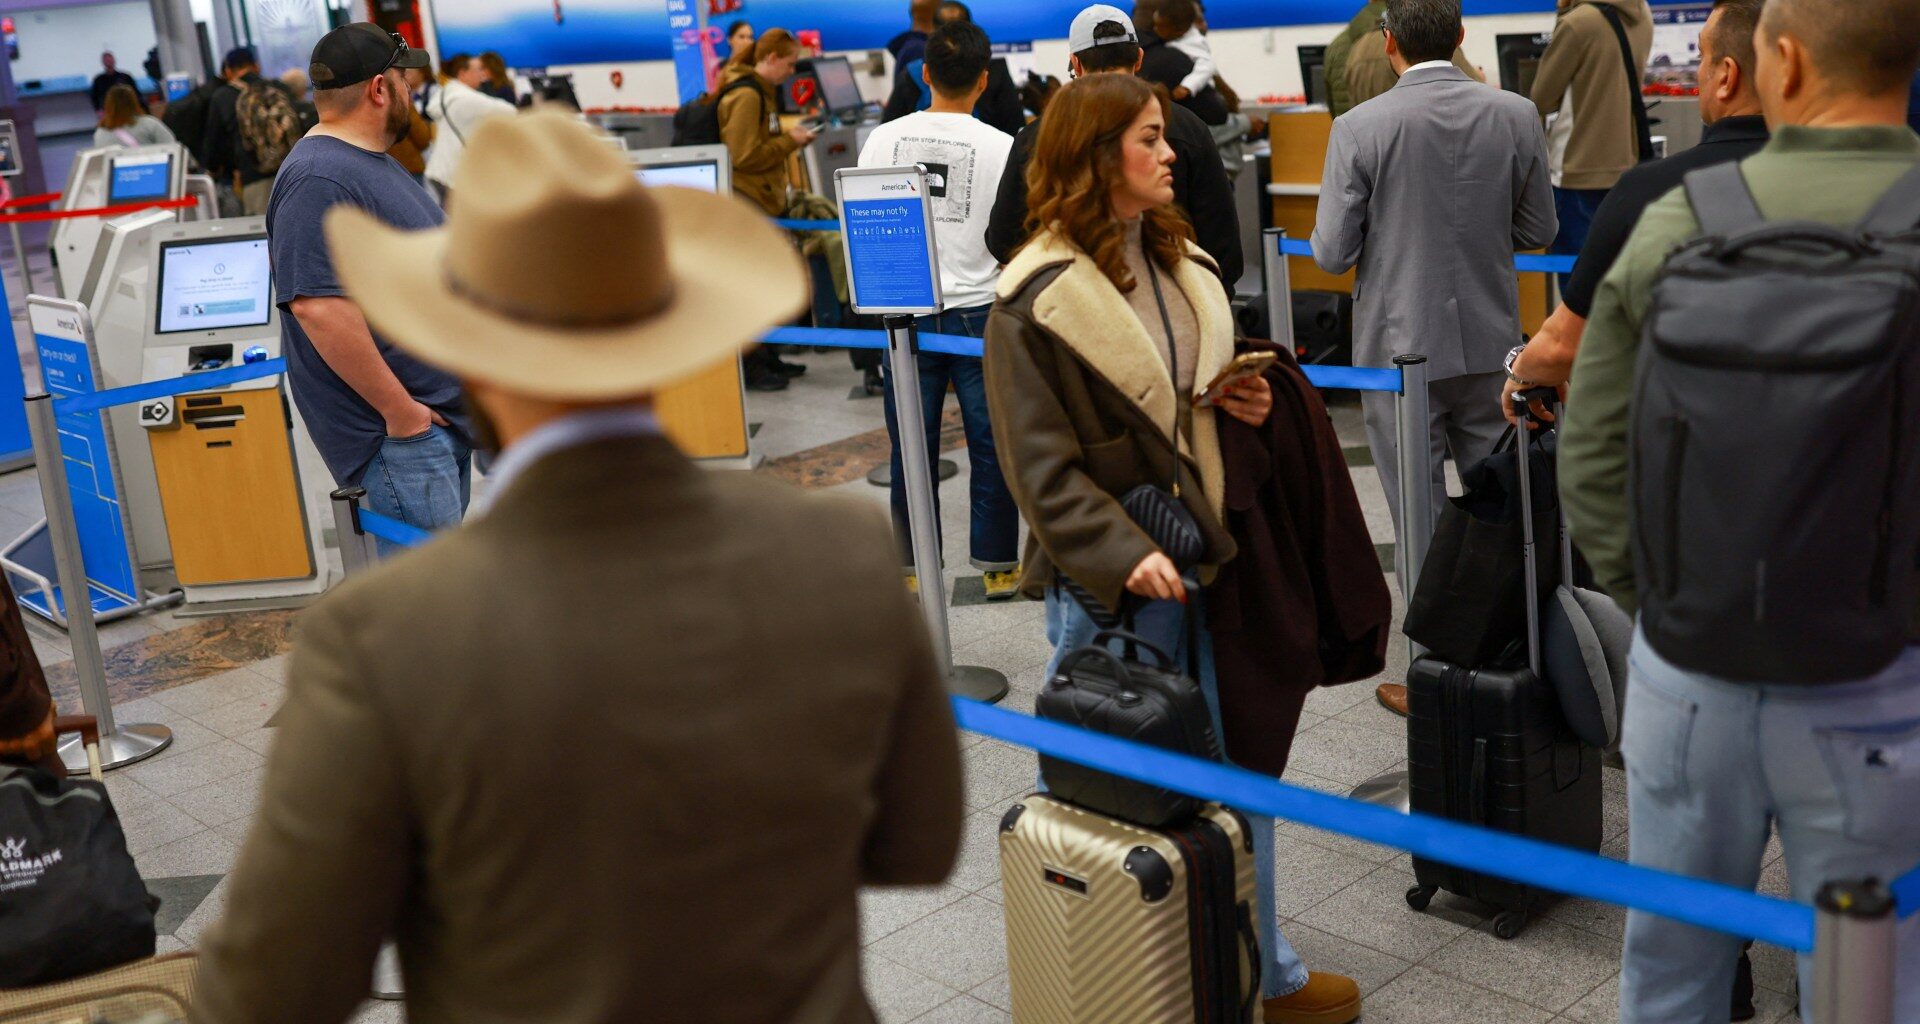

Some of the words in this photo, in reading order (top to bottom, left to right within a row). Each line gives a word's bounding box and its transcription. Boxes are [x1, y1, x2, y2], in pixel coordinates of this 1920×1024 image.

[937, 139, 972, 148] EXPLORING
[967, 148, 976, 168] NEVER
[965, 168, 974, 185] STOP
[881, 183, 908, 191] American
[964, 185, 972, 218] EXPLORING
[850, 208, 870, 216] These
[871, 209, 885, 218] may
[886, 207, 898, 215] not
[0, 848, 62, 871] LDMARK
